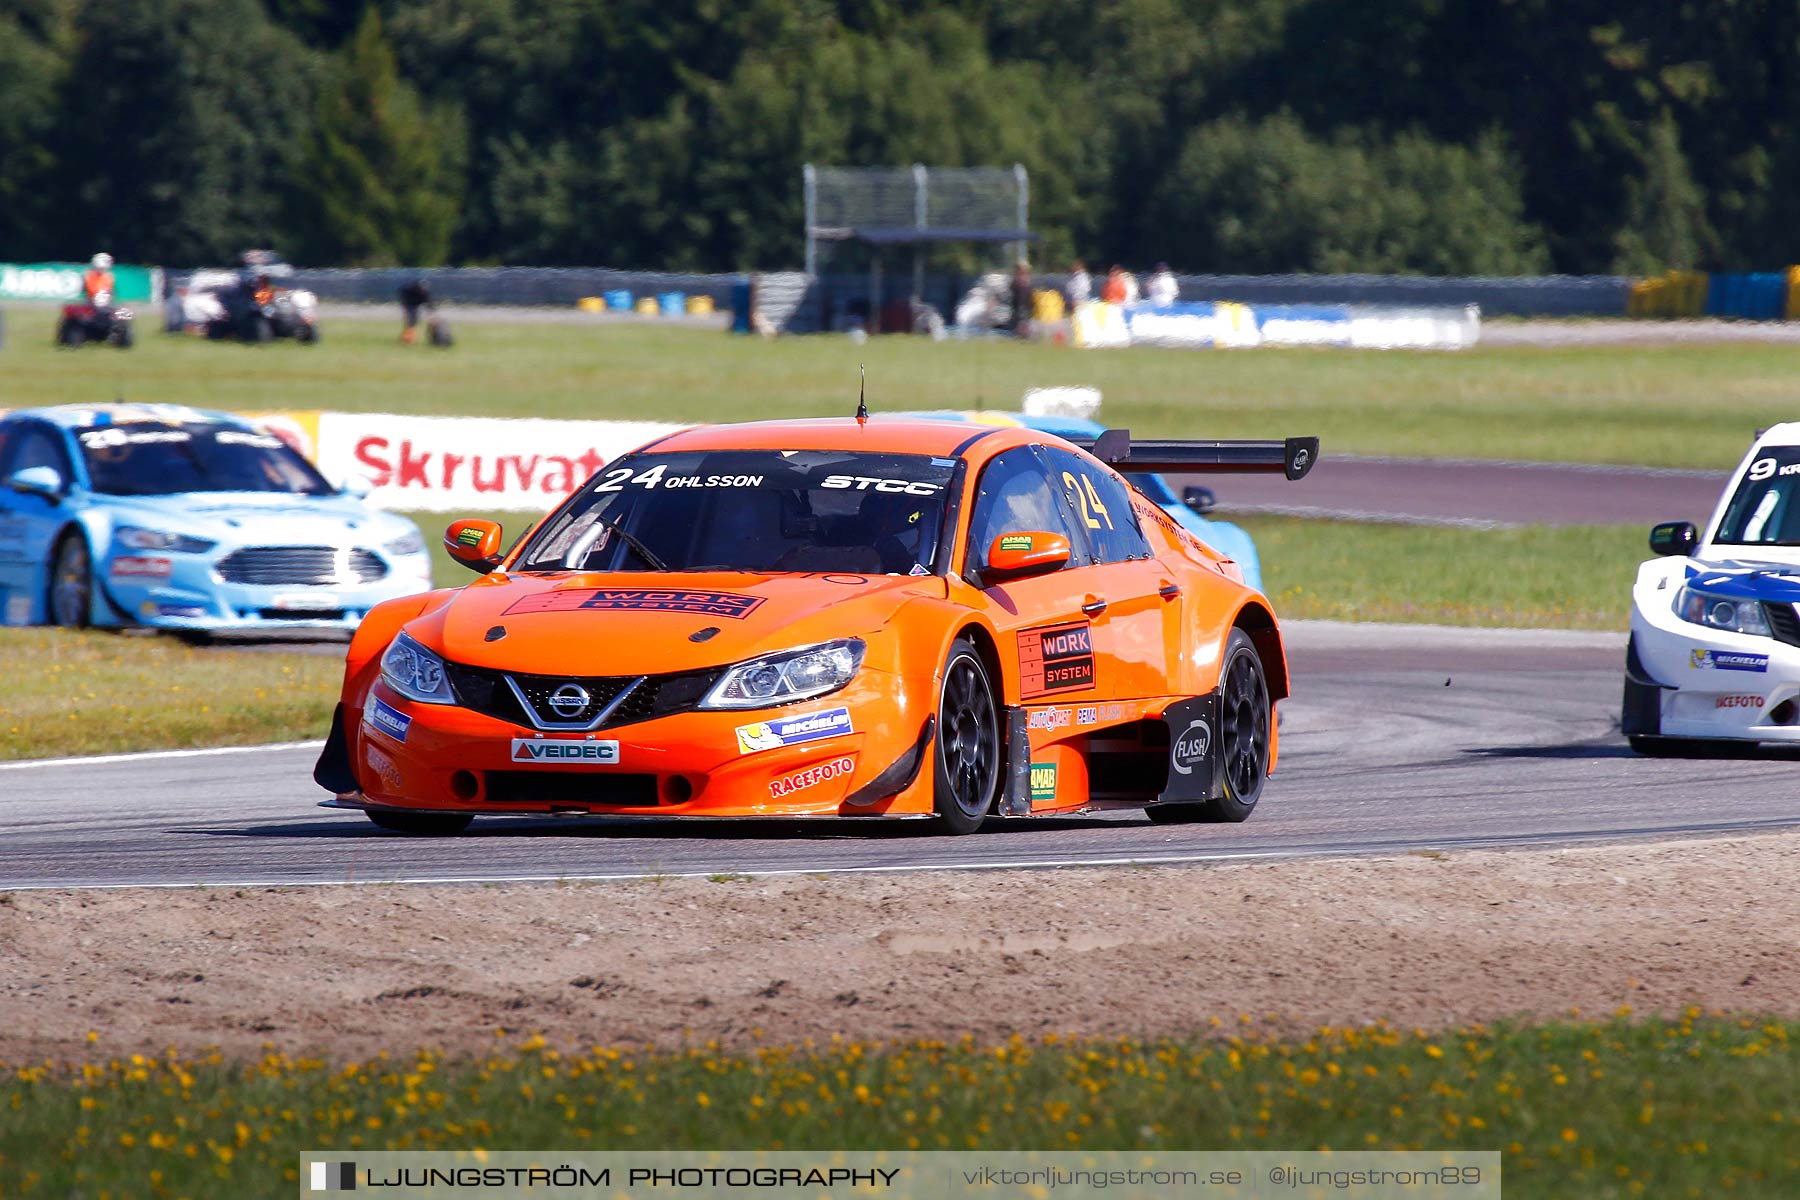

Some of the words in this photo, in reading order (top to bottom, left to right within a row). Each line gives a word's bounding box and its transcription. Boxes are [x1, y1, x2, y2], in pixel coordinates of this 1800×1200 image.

[354, 434, 606, 493] Skruvat
[1748, 458, 1777, 481] 9
[594, 465, 667, 493] 24
[664, 475, 763, 489] OHLSSON
[820, 475, 943, 496] STCC
[1062, 471, 1114, 530] 24
[1002, 536, 1032, 544] AMAB
[593, 602, 733, 613] SYSTEM
[604, 592, 747, 606] WORK
[1043, 632, 1089, 655] WORK
[1717, 655, 1768, 666] MICHELIN
[1047, 665, 1091, 682] SYSTEM
[550, 697, 585, 705] NISSAN
[781, 713, 850, 735] MICHELIN
[528, 745, 613, 758] VEIDEC
[1177, 738, 1206, 758] FLASH
[769, 758, 854, 798] RACEFOTO
[1031, 768, 1055, 788] AMAB
